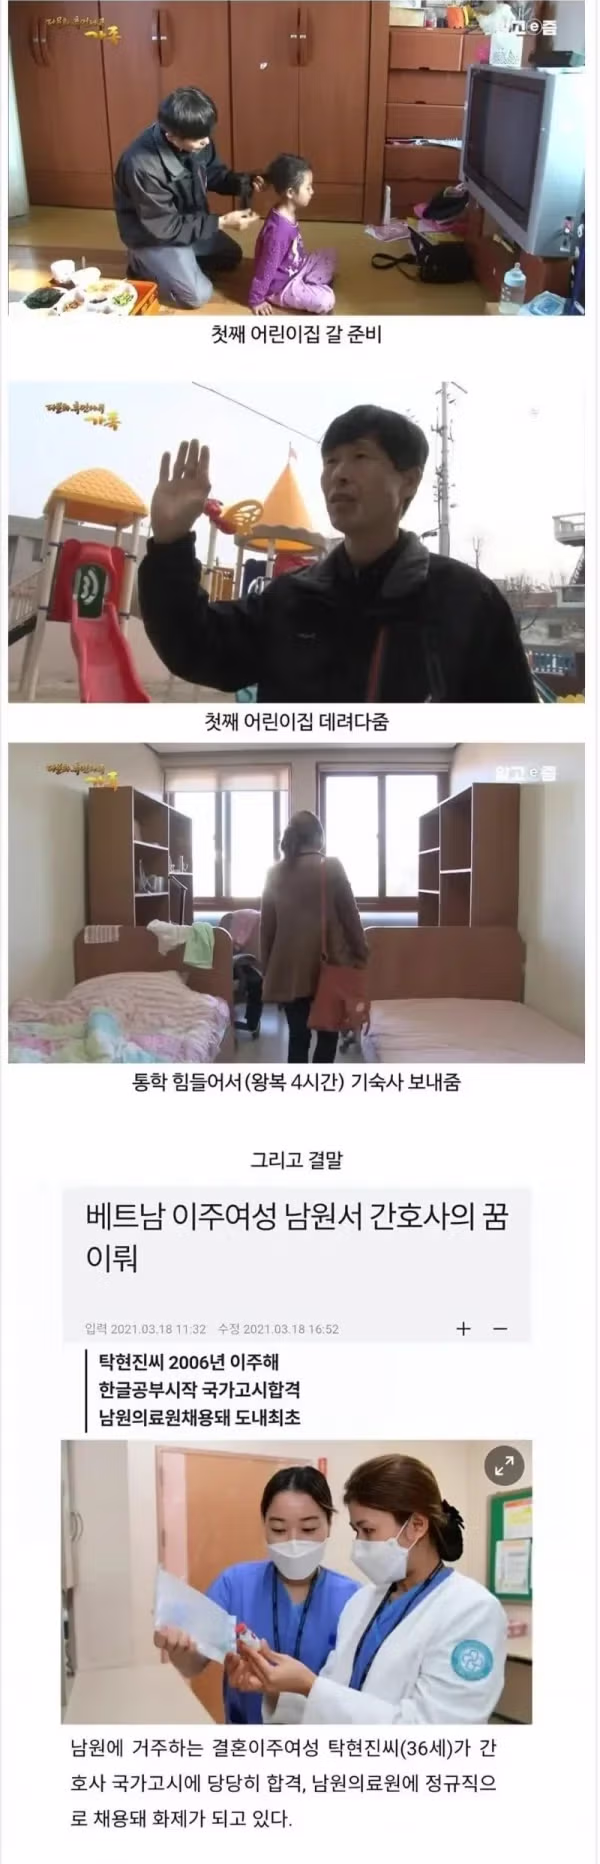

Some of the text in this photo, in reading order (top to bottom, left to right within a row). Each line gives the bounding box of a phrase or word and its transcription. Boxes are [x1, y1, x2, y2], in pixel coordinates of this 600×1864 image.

[86, 1201, 509, 1232] 베트남 이주여성 남원서 간호사의 꿈
[86, 1244, 137, 1274] 이뤄
[85, 1322, 340, 1336] 입력 2021.03.18 11:32 수정 2021.03.18 16:52
[99, 1352, 279, 1372] 탁현진씨 2006년 이주해
[98, 1380, 300, 1400] 한글공부시작 국가고시합격
[99, 1408, 301, 1427] 남원의료원채용돼 도내최초
[71, 1738, 497, 1760] 남원에 거주하는 결혼이주여성 탁현진씨(36세)가 간
[70, 1773, 497, 1794] 호사 국가고시에 당당히 합격, 남원의료원에 정규직으
[70, 1809, 292, 1829] 로 채용돼 화제가 되고 있다.
